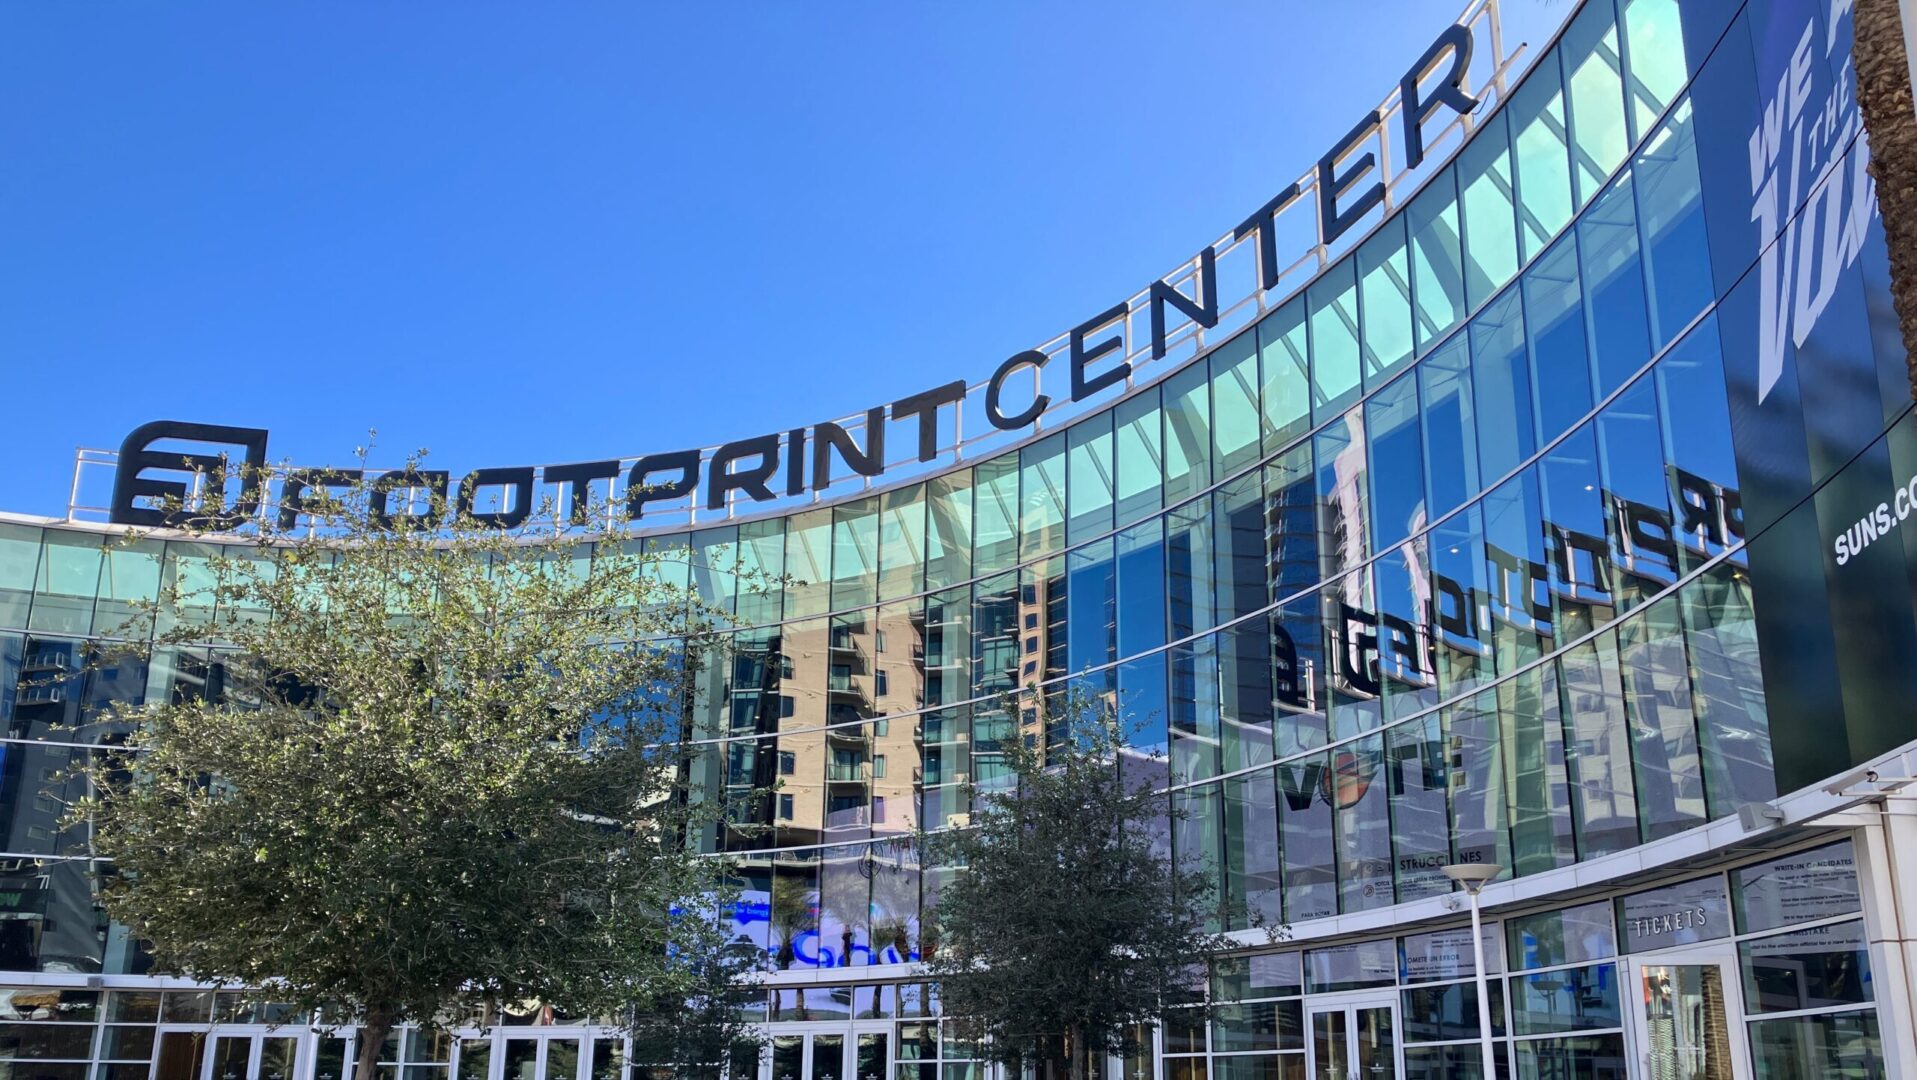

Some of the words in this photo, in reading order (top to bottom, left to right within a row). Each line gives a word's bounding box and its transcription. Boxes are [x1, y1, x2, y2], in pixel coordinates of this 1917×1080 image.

[1749, 17, 1813, 196] WE
[1808, 54, 1851, 172] THE
[277, 379, 966, 531] FOOTPRINT
[985, 24, 1479, 430] CENTER
[1635, 907, 1707, 938] TICKETS
